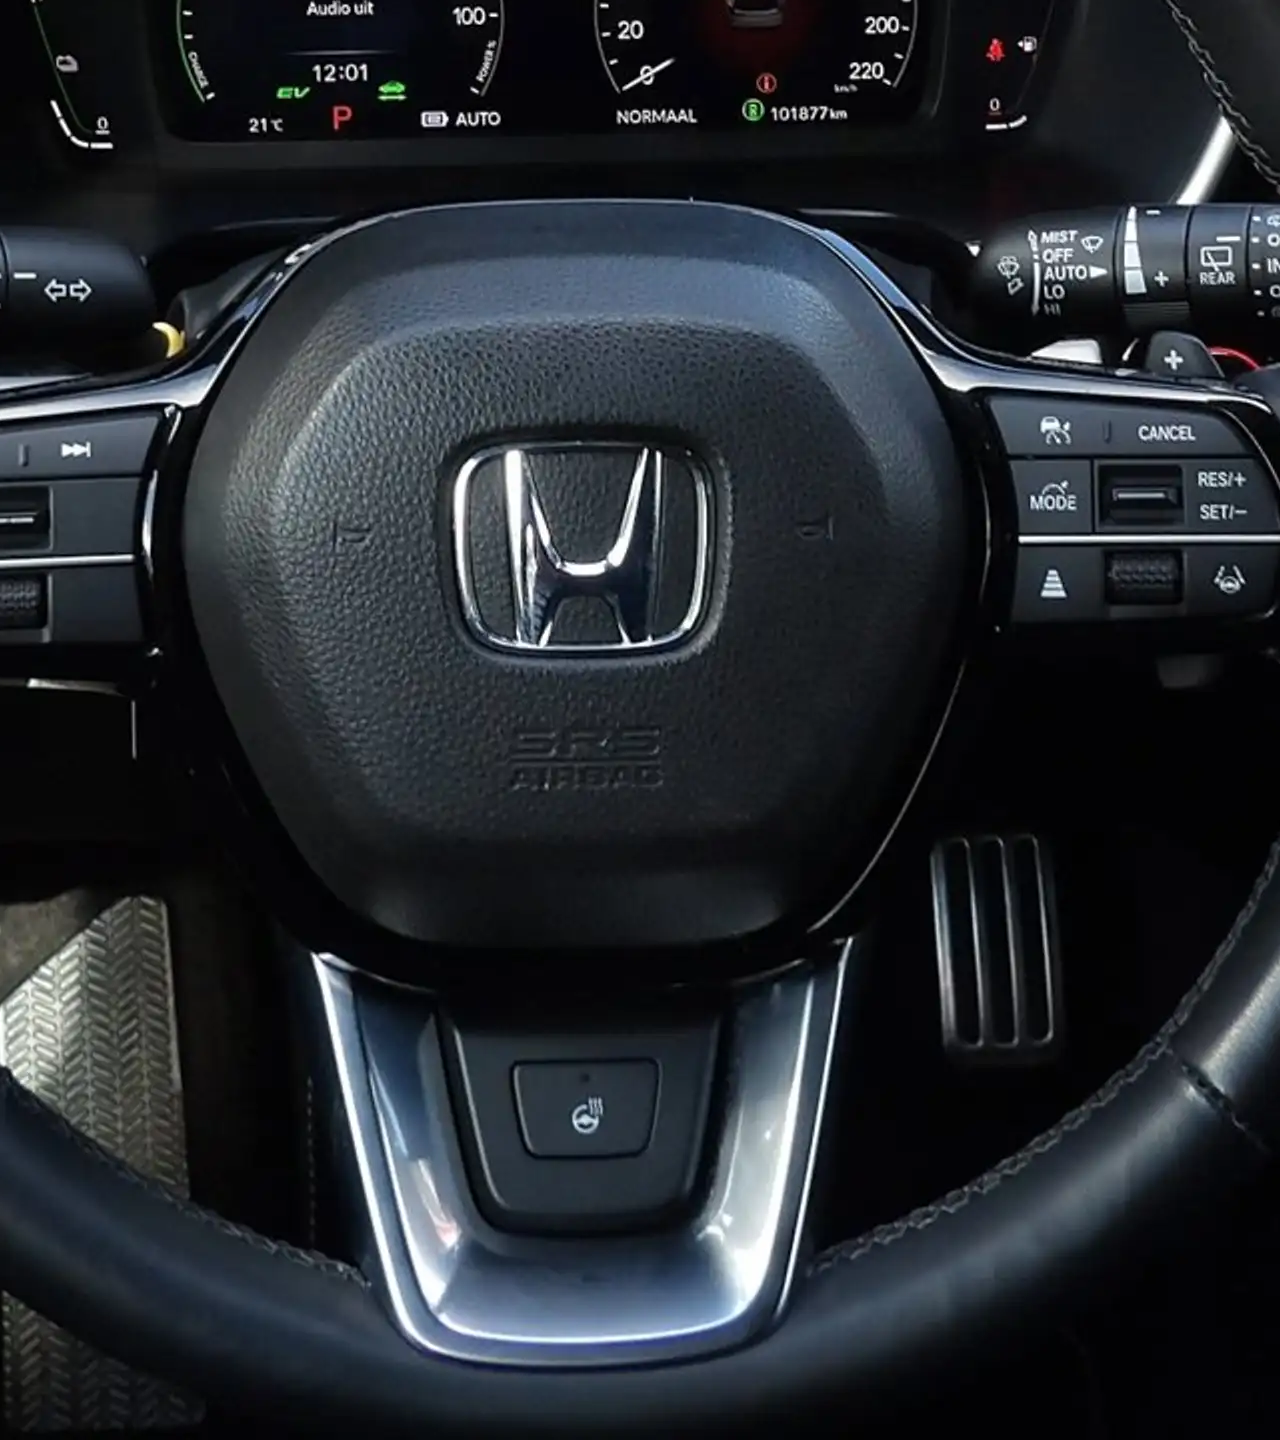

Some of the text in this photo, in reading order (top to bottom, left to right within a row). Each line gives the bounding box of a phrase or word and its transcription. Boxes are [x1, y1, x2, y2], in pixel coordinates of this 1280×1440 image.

[306, 0, 374, 16] Audio uit
[452, 6, 486, 26] 100
[617, 19, 644, 40] 20
[864, 15, 900, 35] 200
[312, 63, 368, 83] 12:01
[847, 61, 885, 80] 220
[276, 86, 311, 99] EV
[989, 97, 1001, 112] 0
[332, 105, 353, 131] P
[455, 111, 502, 127] AUTO
[616, 108, 698, 124] NORMAAL
[770, 105, 848, 122] 101877 km
[96, 116, 109, 131] 0
[1040, 229, 1079, 245] MIST
[1042, 247, 1075, 264] OFF
[1043, 262, 1088, 281] AUTO
[1199, 269, 1236, 285] REAR
[1043, 283, 1066, 300] LO
[1137, 424, 1196, 442] CANCEL
[1197, 471, 1247, 488] RES/+
[1028, 494, 1079, 511] MODE
[511, 732, 661, 759] SRS
